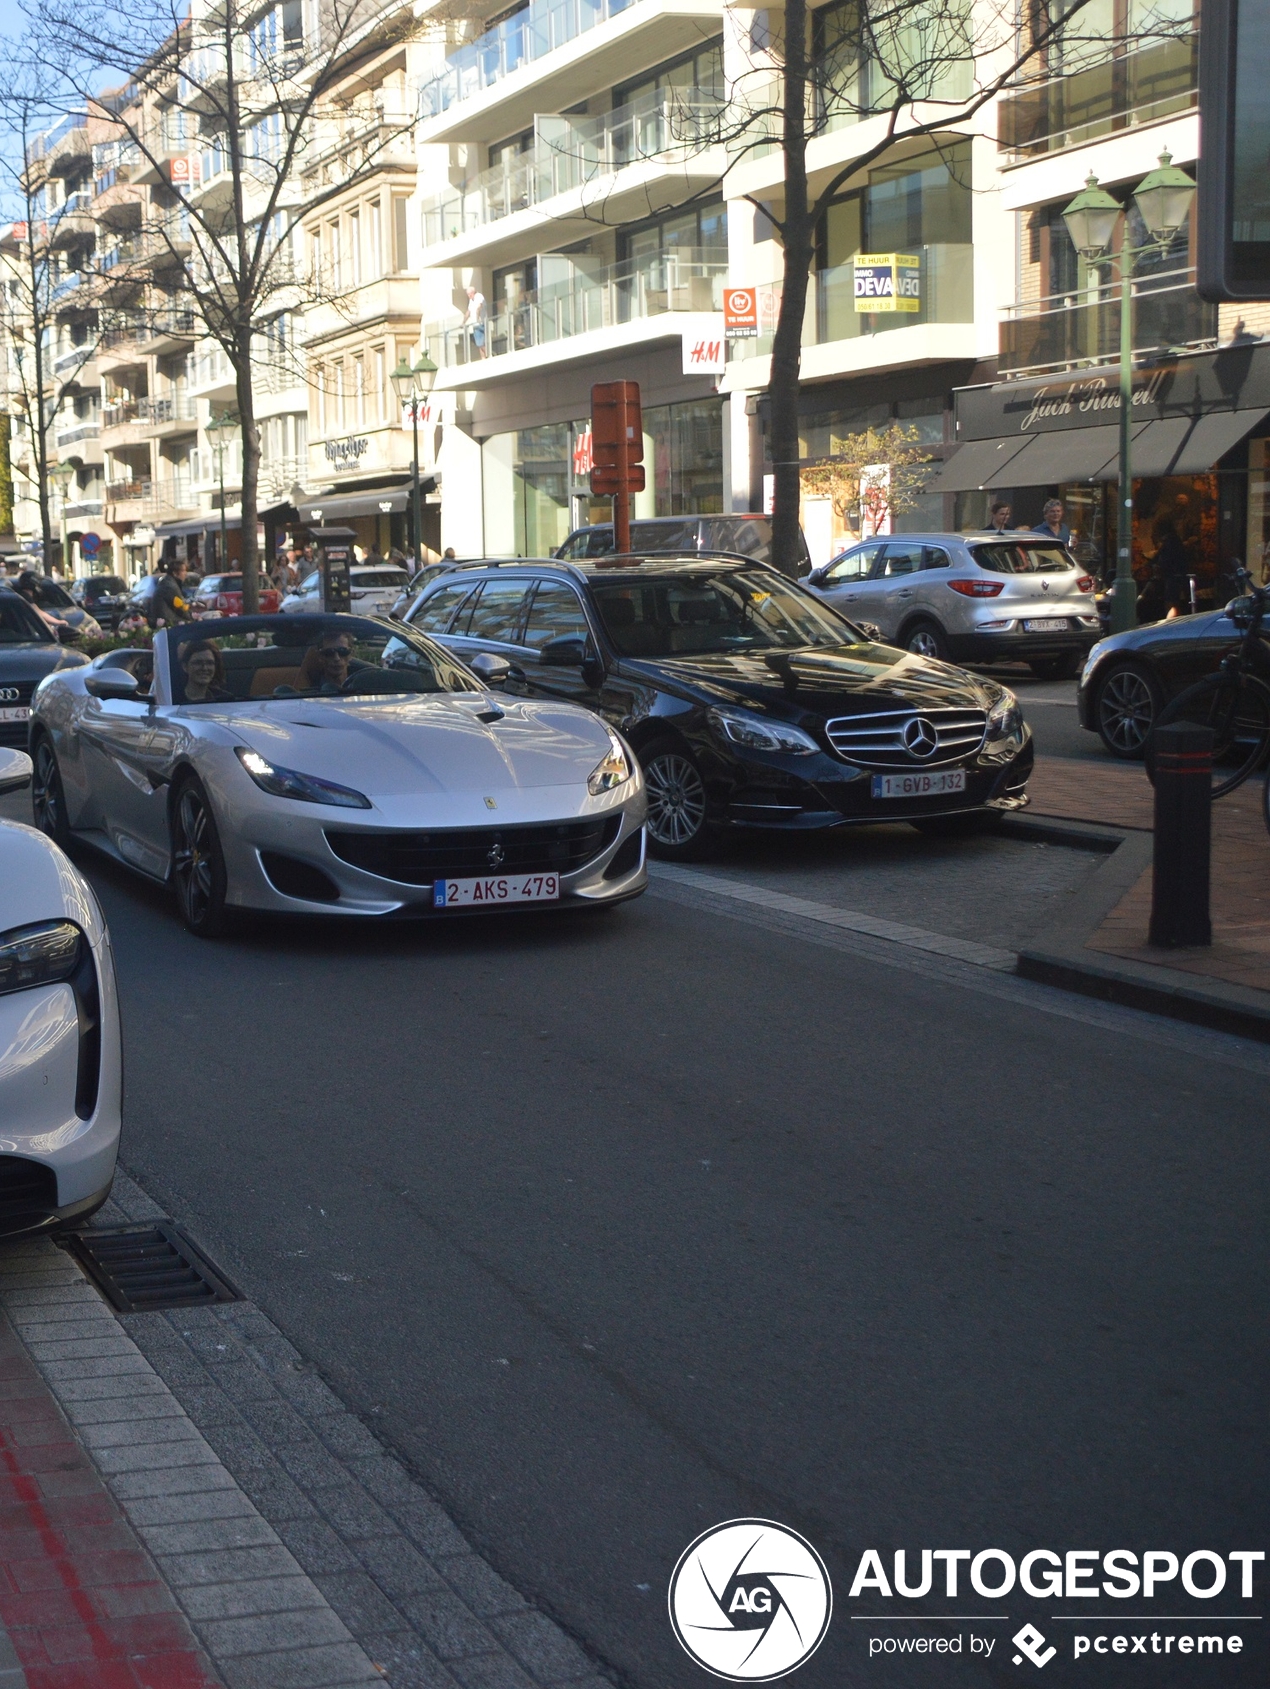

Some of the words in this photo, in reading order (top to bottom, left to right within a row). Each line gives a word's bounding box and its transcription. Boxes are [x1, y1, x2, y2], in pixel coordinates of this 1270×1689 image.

[854, 277, 893, 296] DEVA
[690, 341, 721, 363] H&M
[1020, 382, 1077, 431] Jack
[1079, 369, 1168, 412] Rusell
[884, 774, 962, 794] 1-GVB-132
[447, 876, 557, 902] 2-AKS-479
